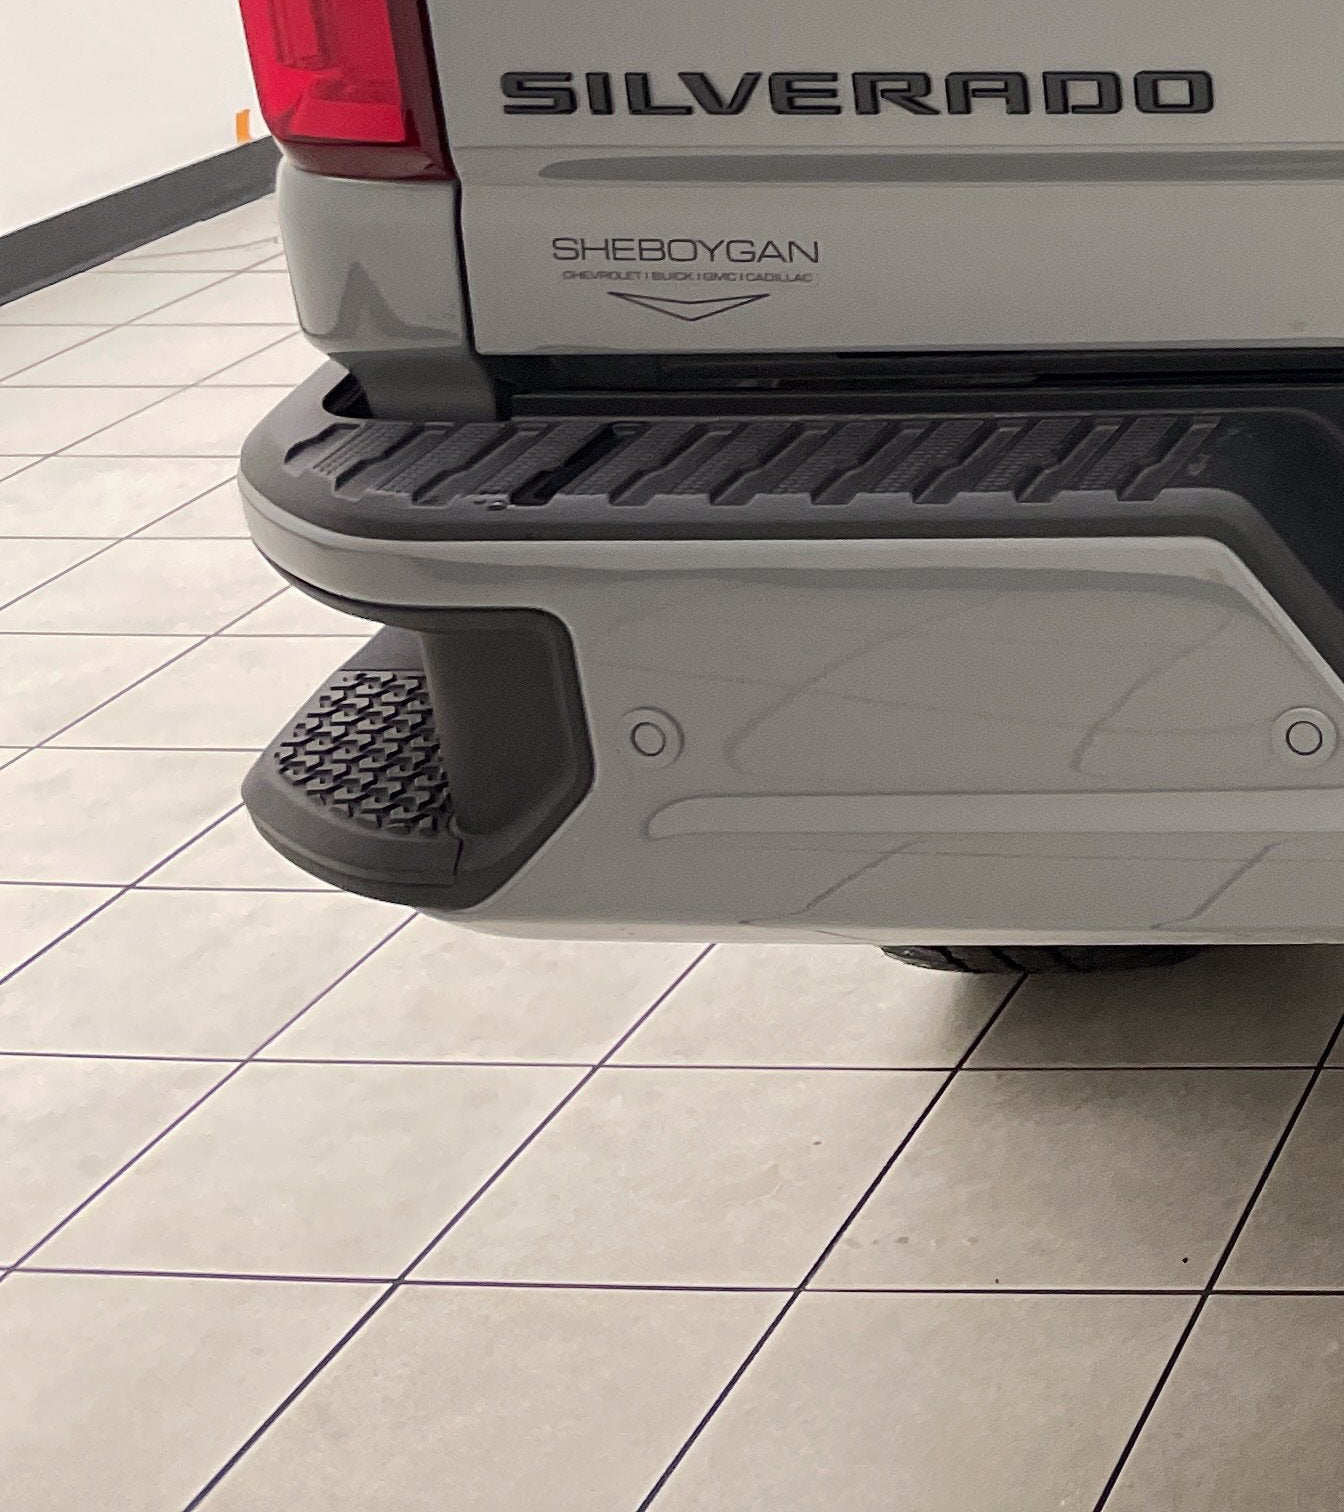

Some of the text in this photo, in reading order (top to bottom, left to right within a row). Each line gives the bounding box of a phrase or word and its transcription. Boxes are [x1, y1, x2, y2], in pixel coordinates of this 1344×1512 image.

[499, 69, 1215, 116] SILVERADO
[551, 237, 819, 264] SHEBOYGAN
[562, 270, 814, 283] CHEVROLET BUICK GMC CADILLAC
